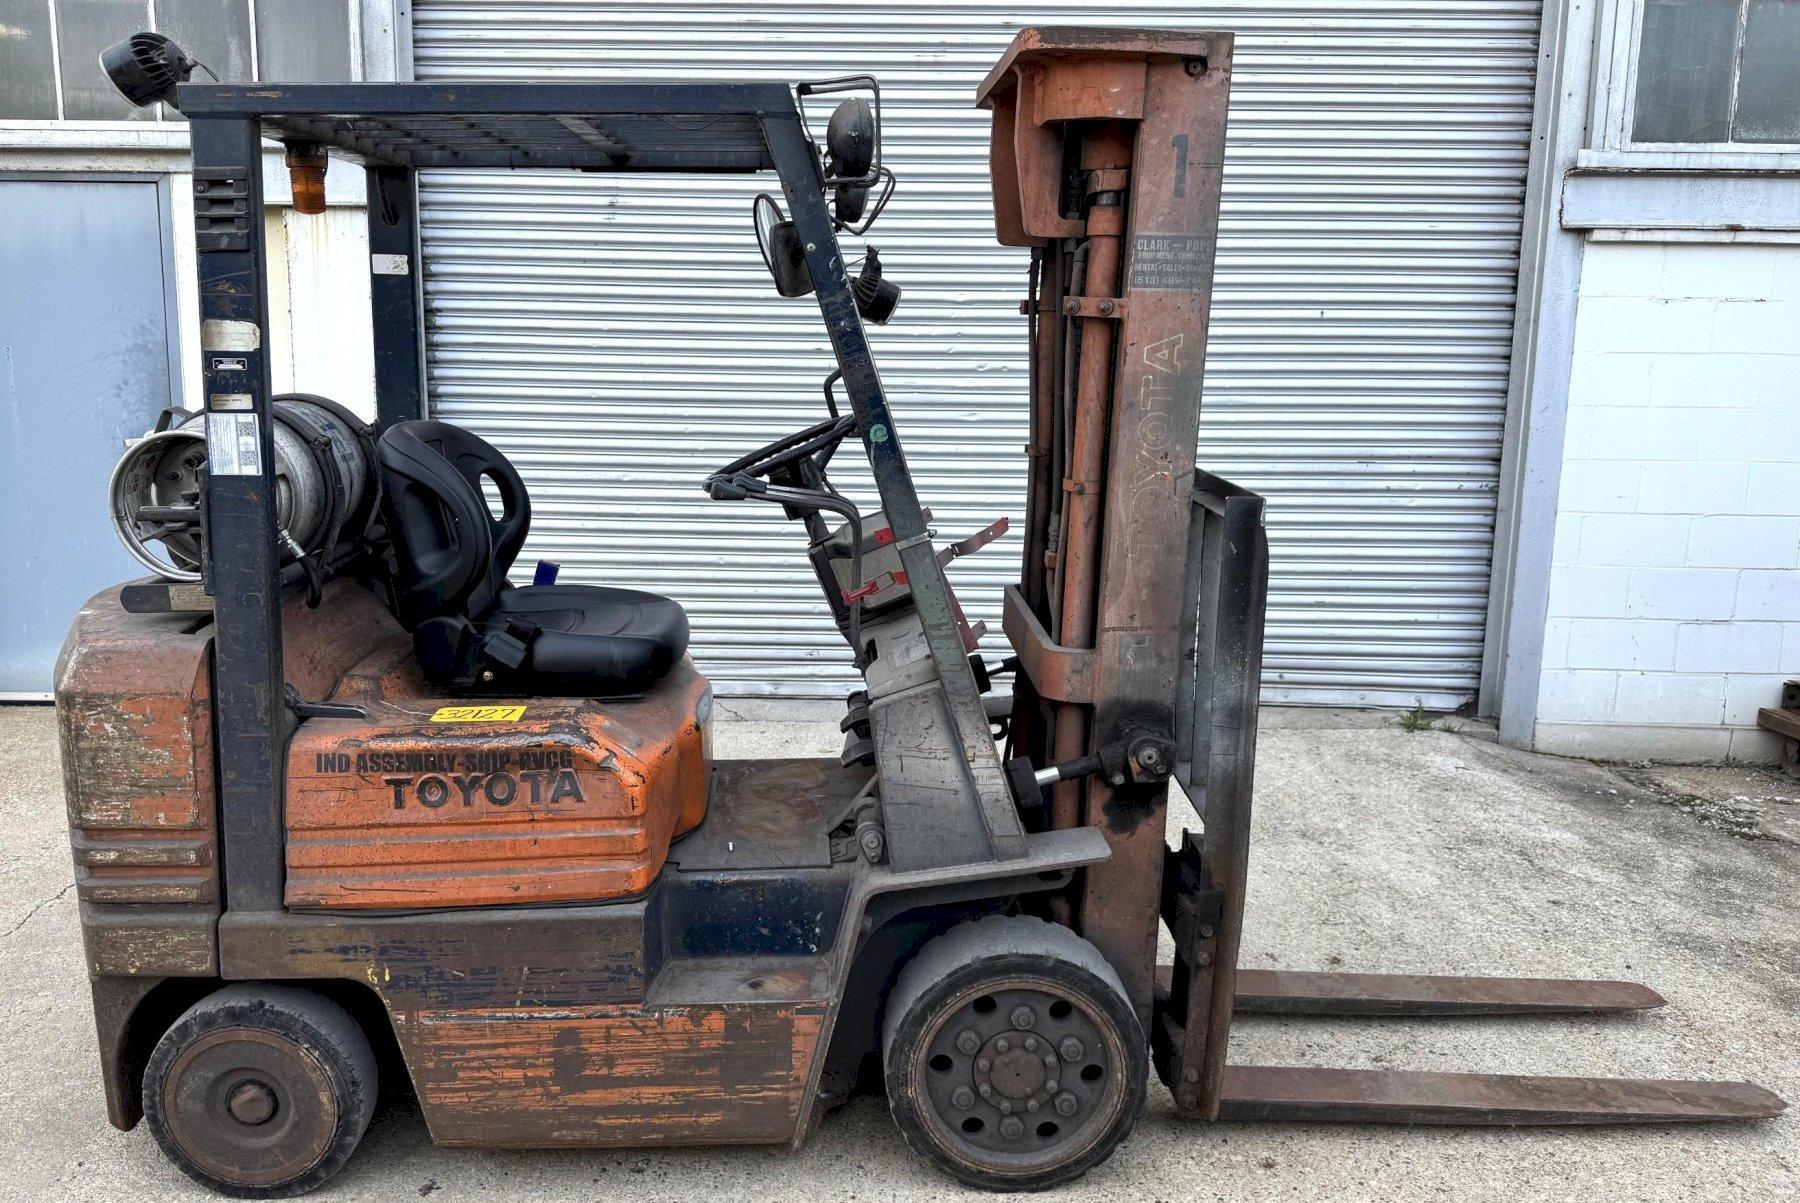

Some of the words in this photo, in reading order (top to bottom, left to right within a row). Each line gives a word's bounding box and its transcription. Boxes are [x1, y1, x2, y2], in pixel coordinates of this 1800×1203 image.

[1172, 134, 1189, 198] 1
[1137, 239, 1169, 251] CLARK
[1138, 251, 1174, 260] EQUIPMENT
[438, 708, 518, 719] 32127
[316, 752, 351, 773] IND
[381, 768, 586, 810] TOYOTA
